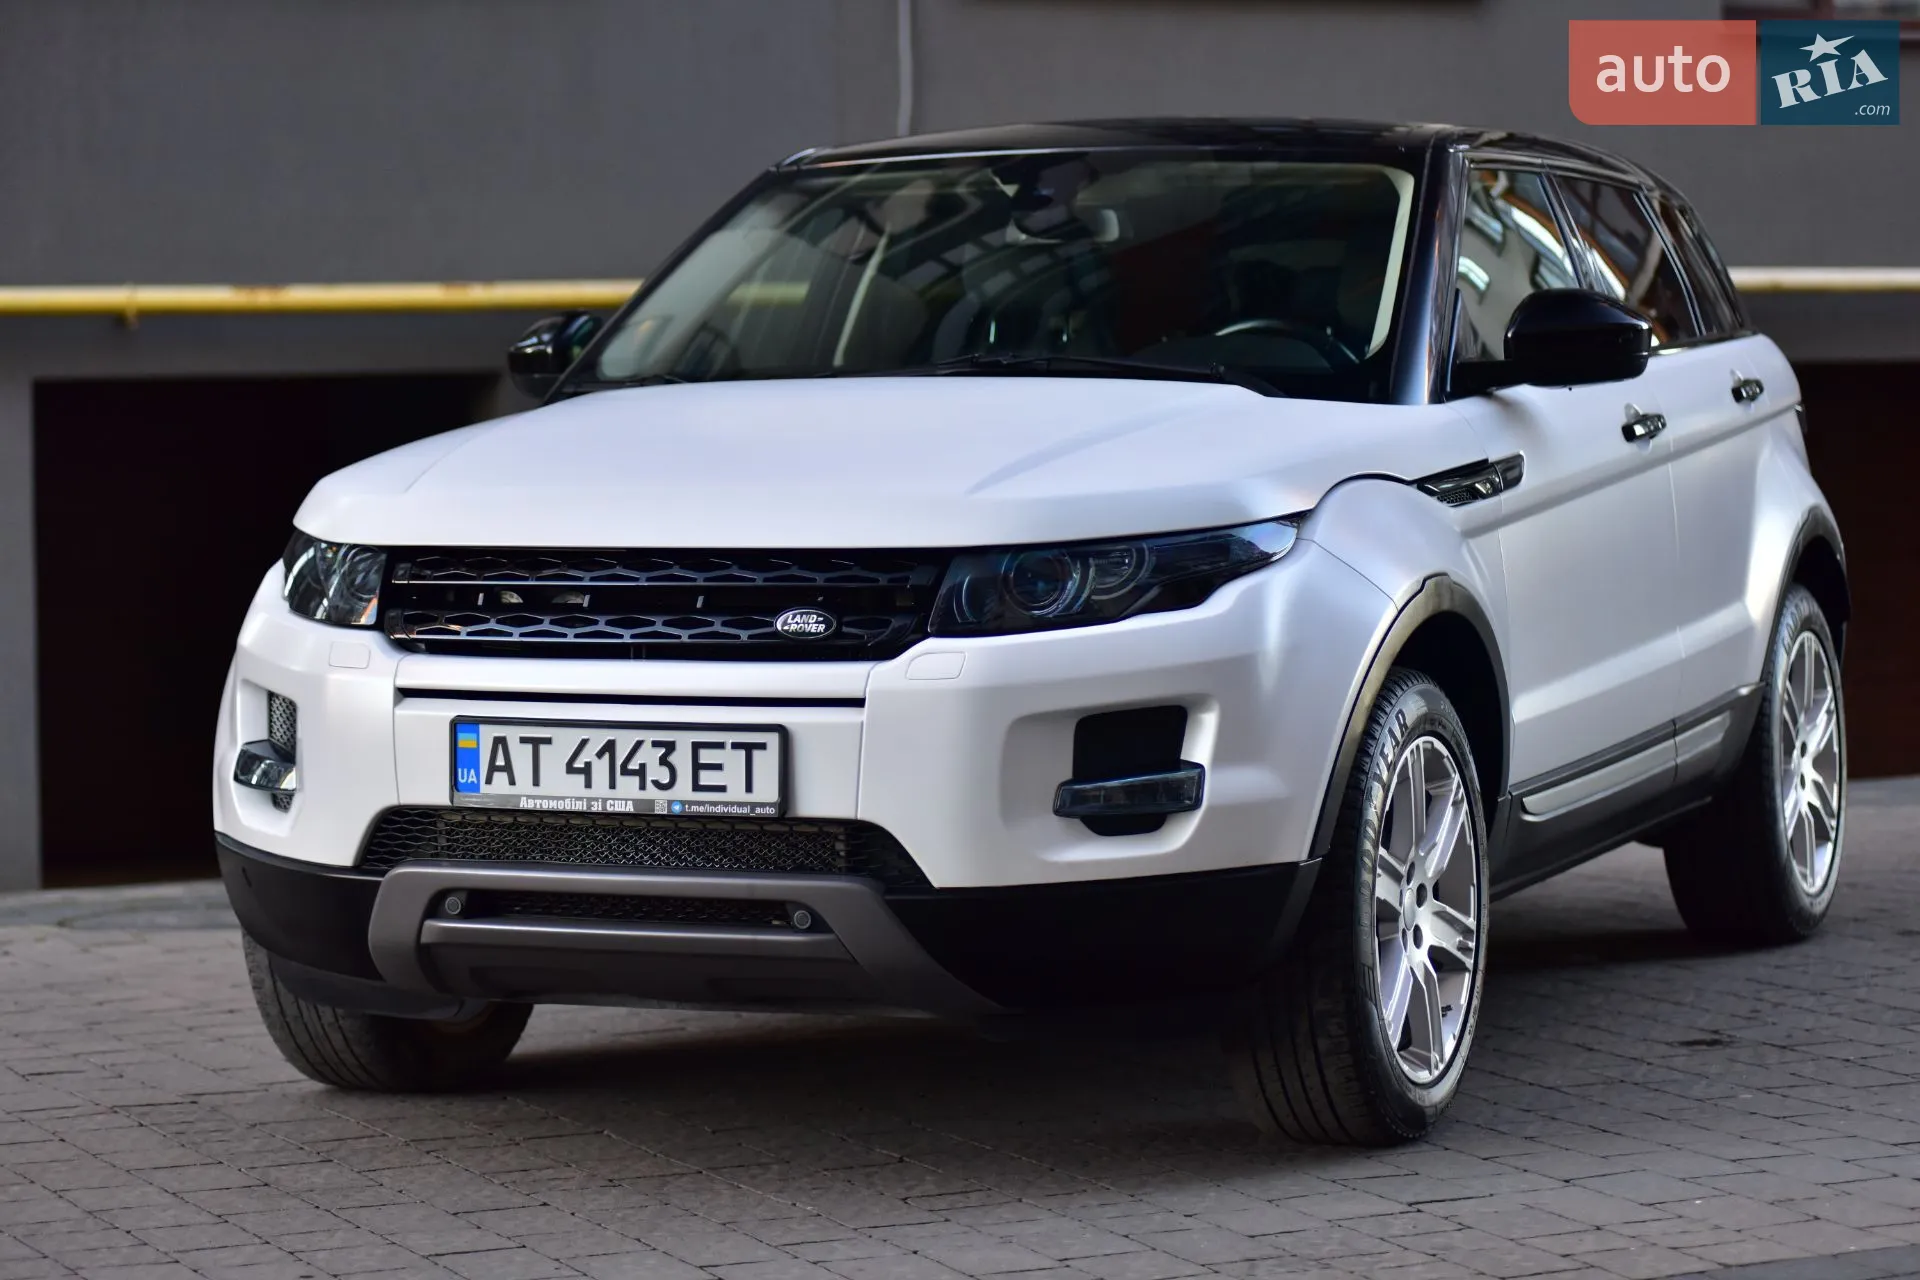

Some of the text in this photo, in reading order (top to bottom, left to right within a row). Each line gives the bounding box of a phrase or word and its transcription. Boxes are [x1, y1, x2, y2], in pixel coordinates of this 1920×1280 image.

[484, 735, 767, 794] AT 4143 ET
[457, 768, 478, 784] UA
[520, 796, 635, 812] Автомобілі зі США
[685, 803, 776, 816] t.me/individual_auto
